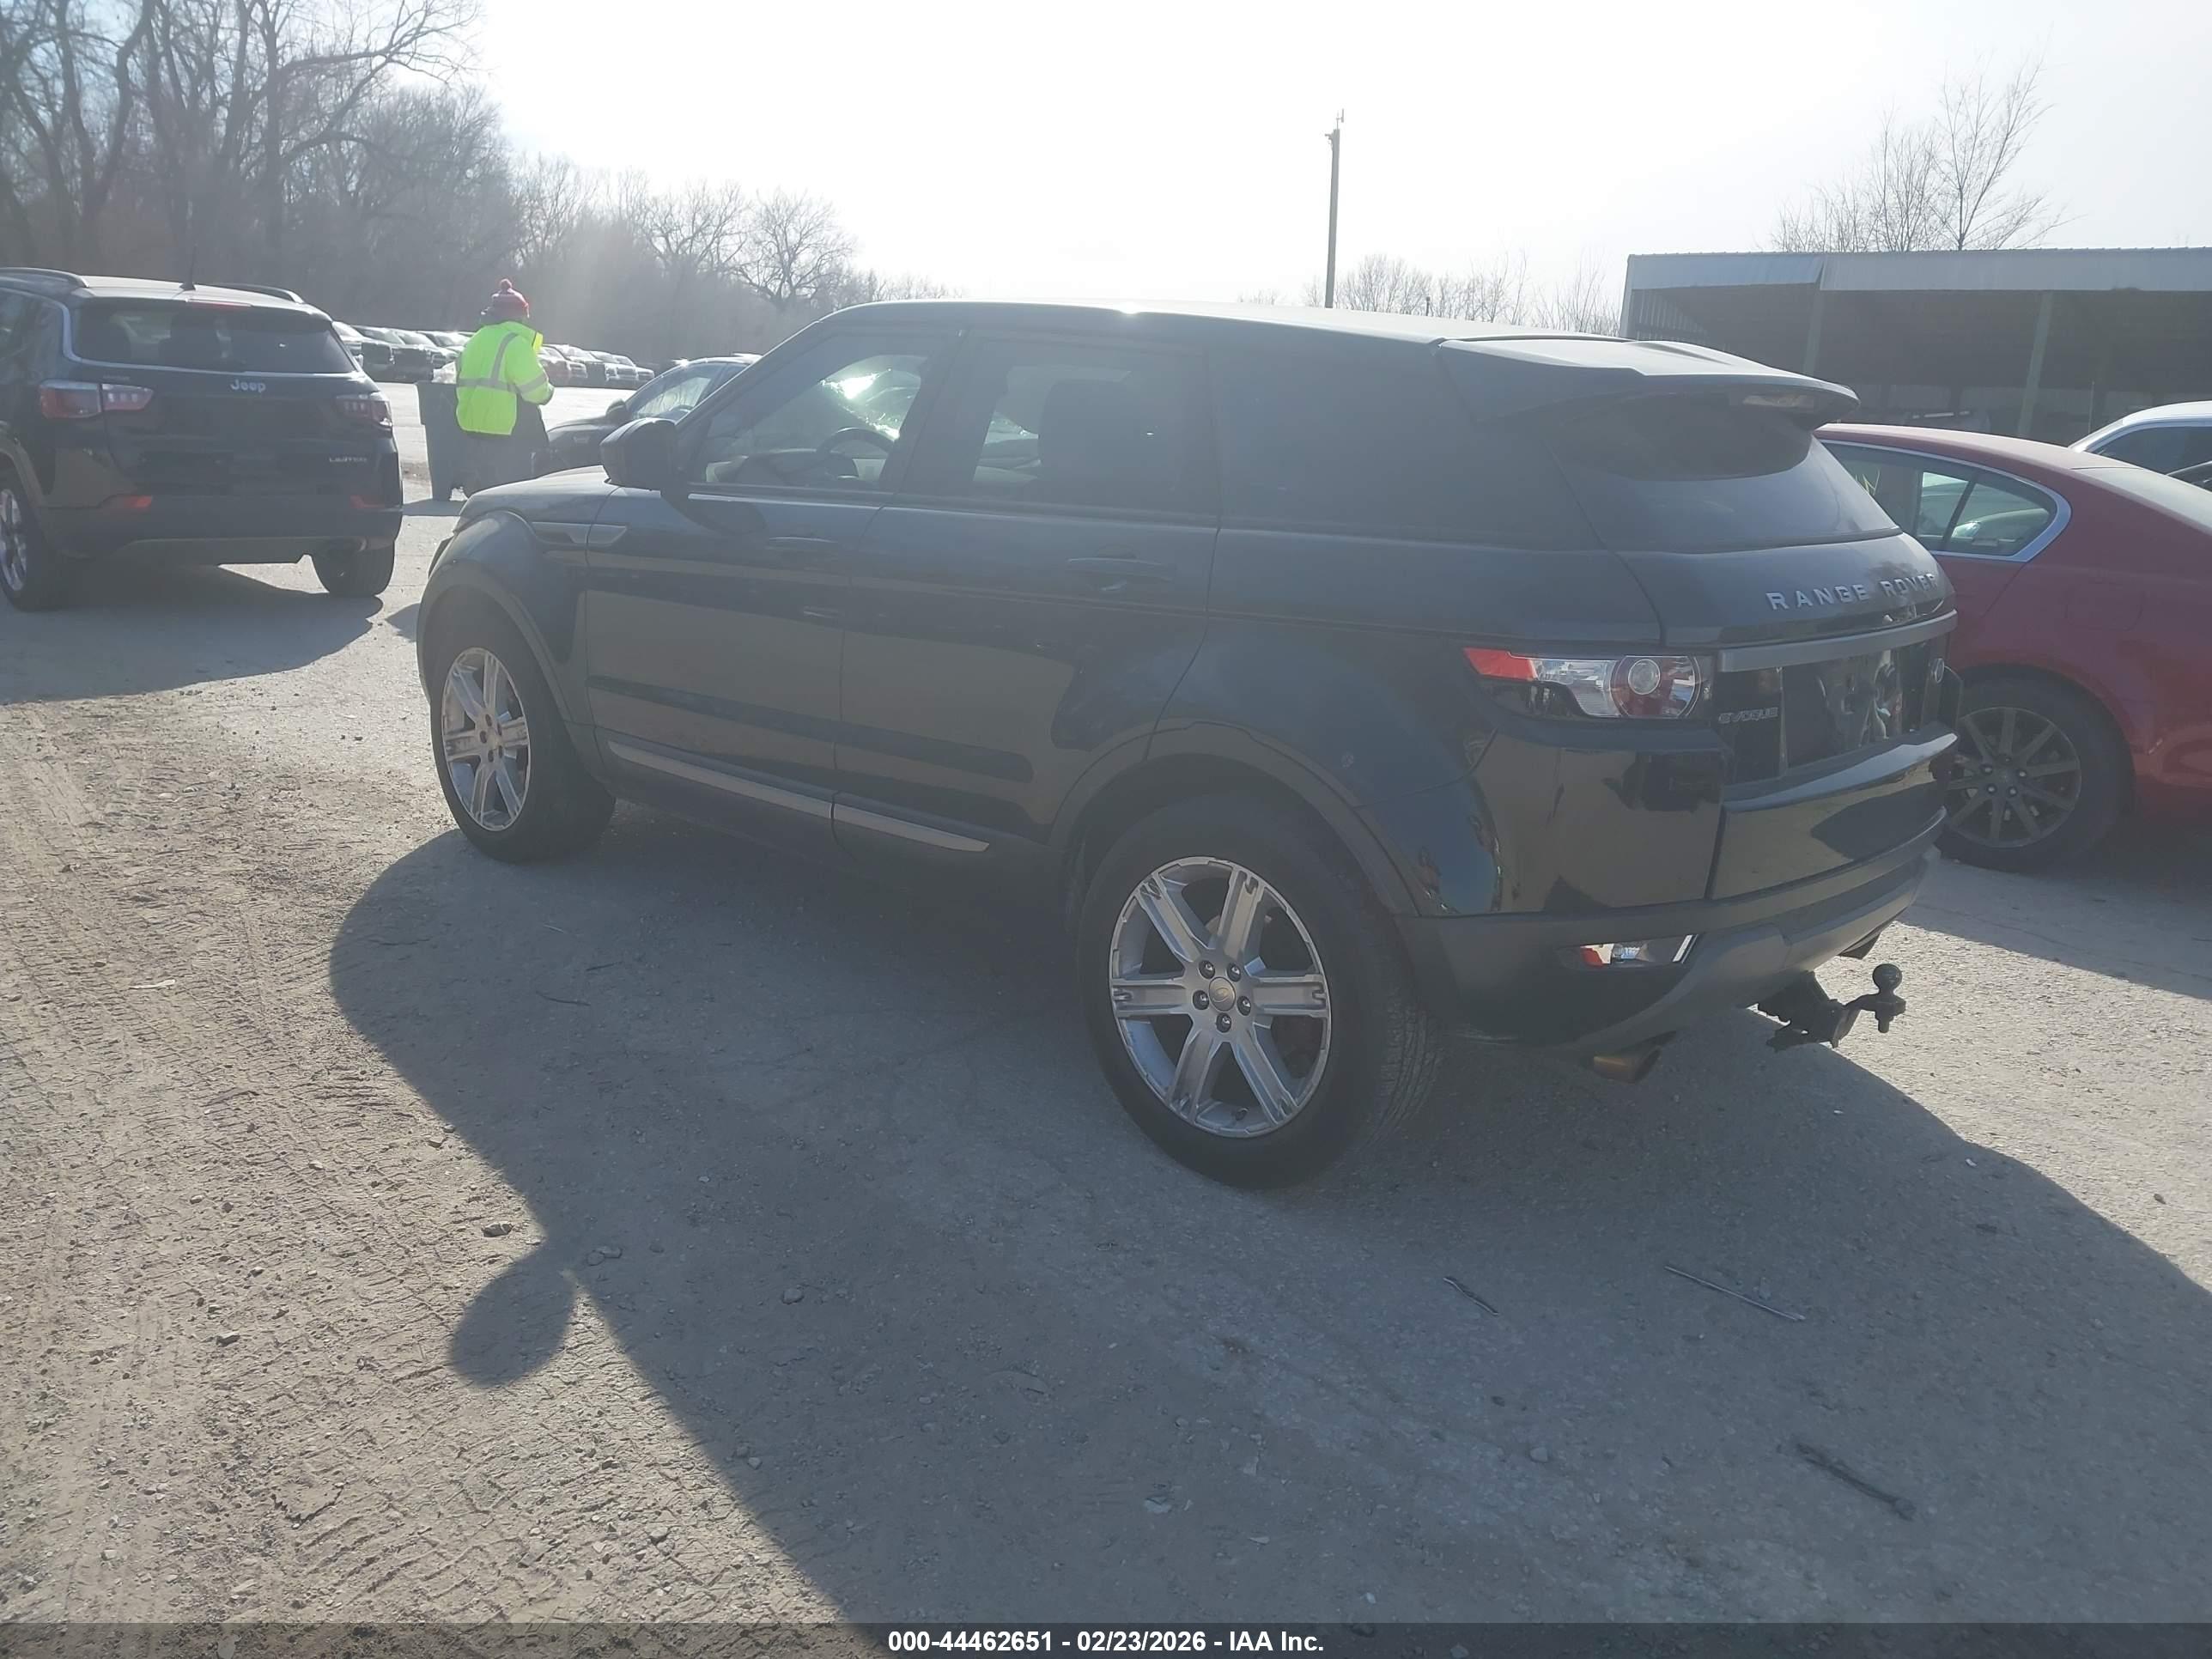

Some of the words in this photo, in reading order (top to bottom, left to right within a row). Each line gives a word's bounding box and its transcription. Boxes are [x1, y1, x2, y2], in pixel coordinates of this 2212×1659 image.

[230, 379, 266, 393] Jeep
[1765, 584, 1869, 611] RANGE
[1880, 573, 1938, 598] ROVER
